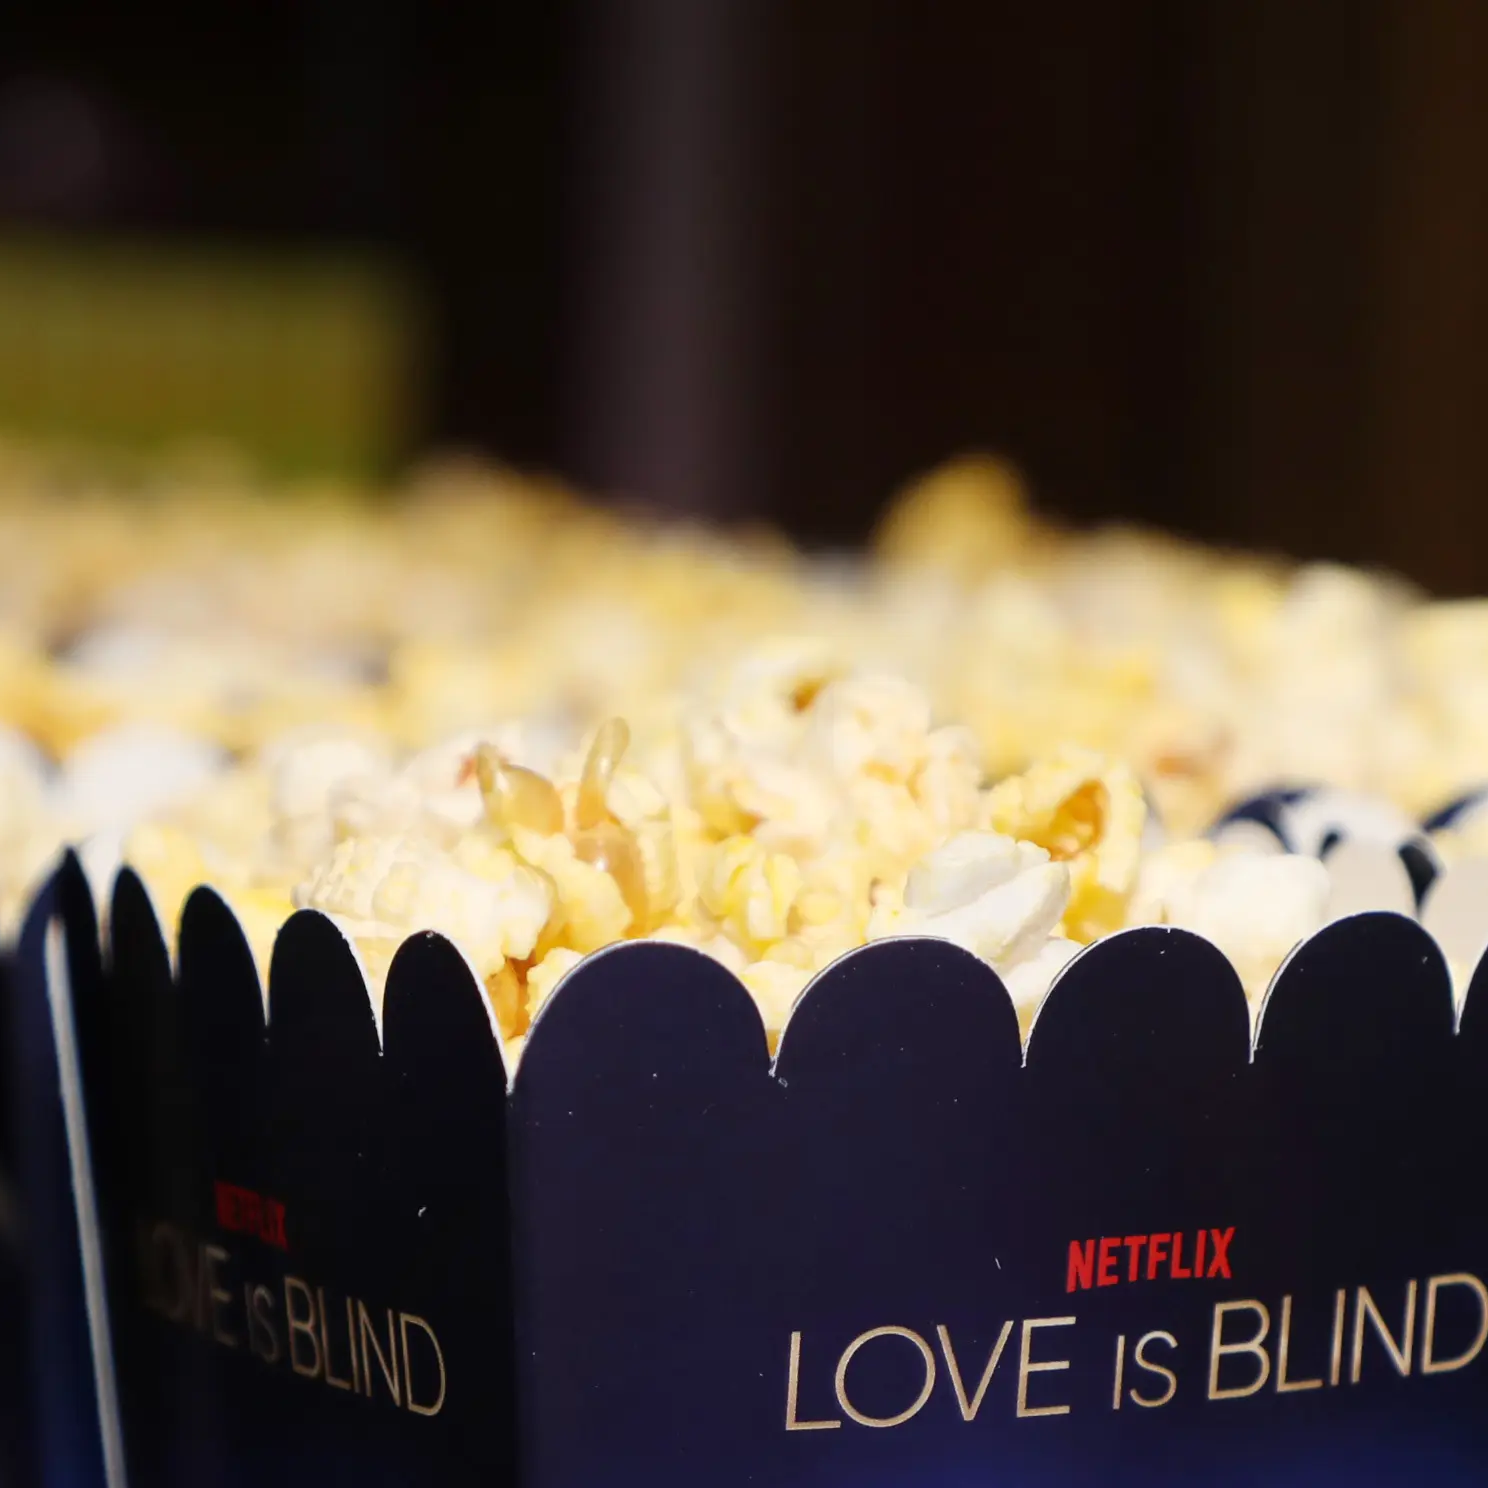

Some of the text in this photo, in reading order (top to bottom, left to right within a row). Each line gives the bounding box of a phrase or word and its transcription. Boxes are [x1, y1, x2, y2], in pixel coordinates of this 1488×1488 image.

[1066, 1227, 1236, 1293] NETFLIX
[243, 1280, 281, 1364] IS
[283, 1273, 447, 1418] BLIND
[785, 1316, 1077, 1431] LOVE
[1112, 1330, 1178, 1411] IS
